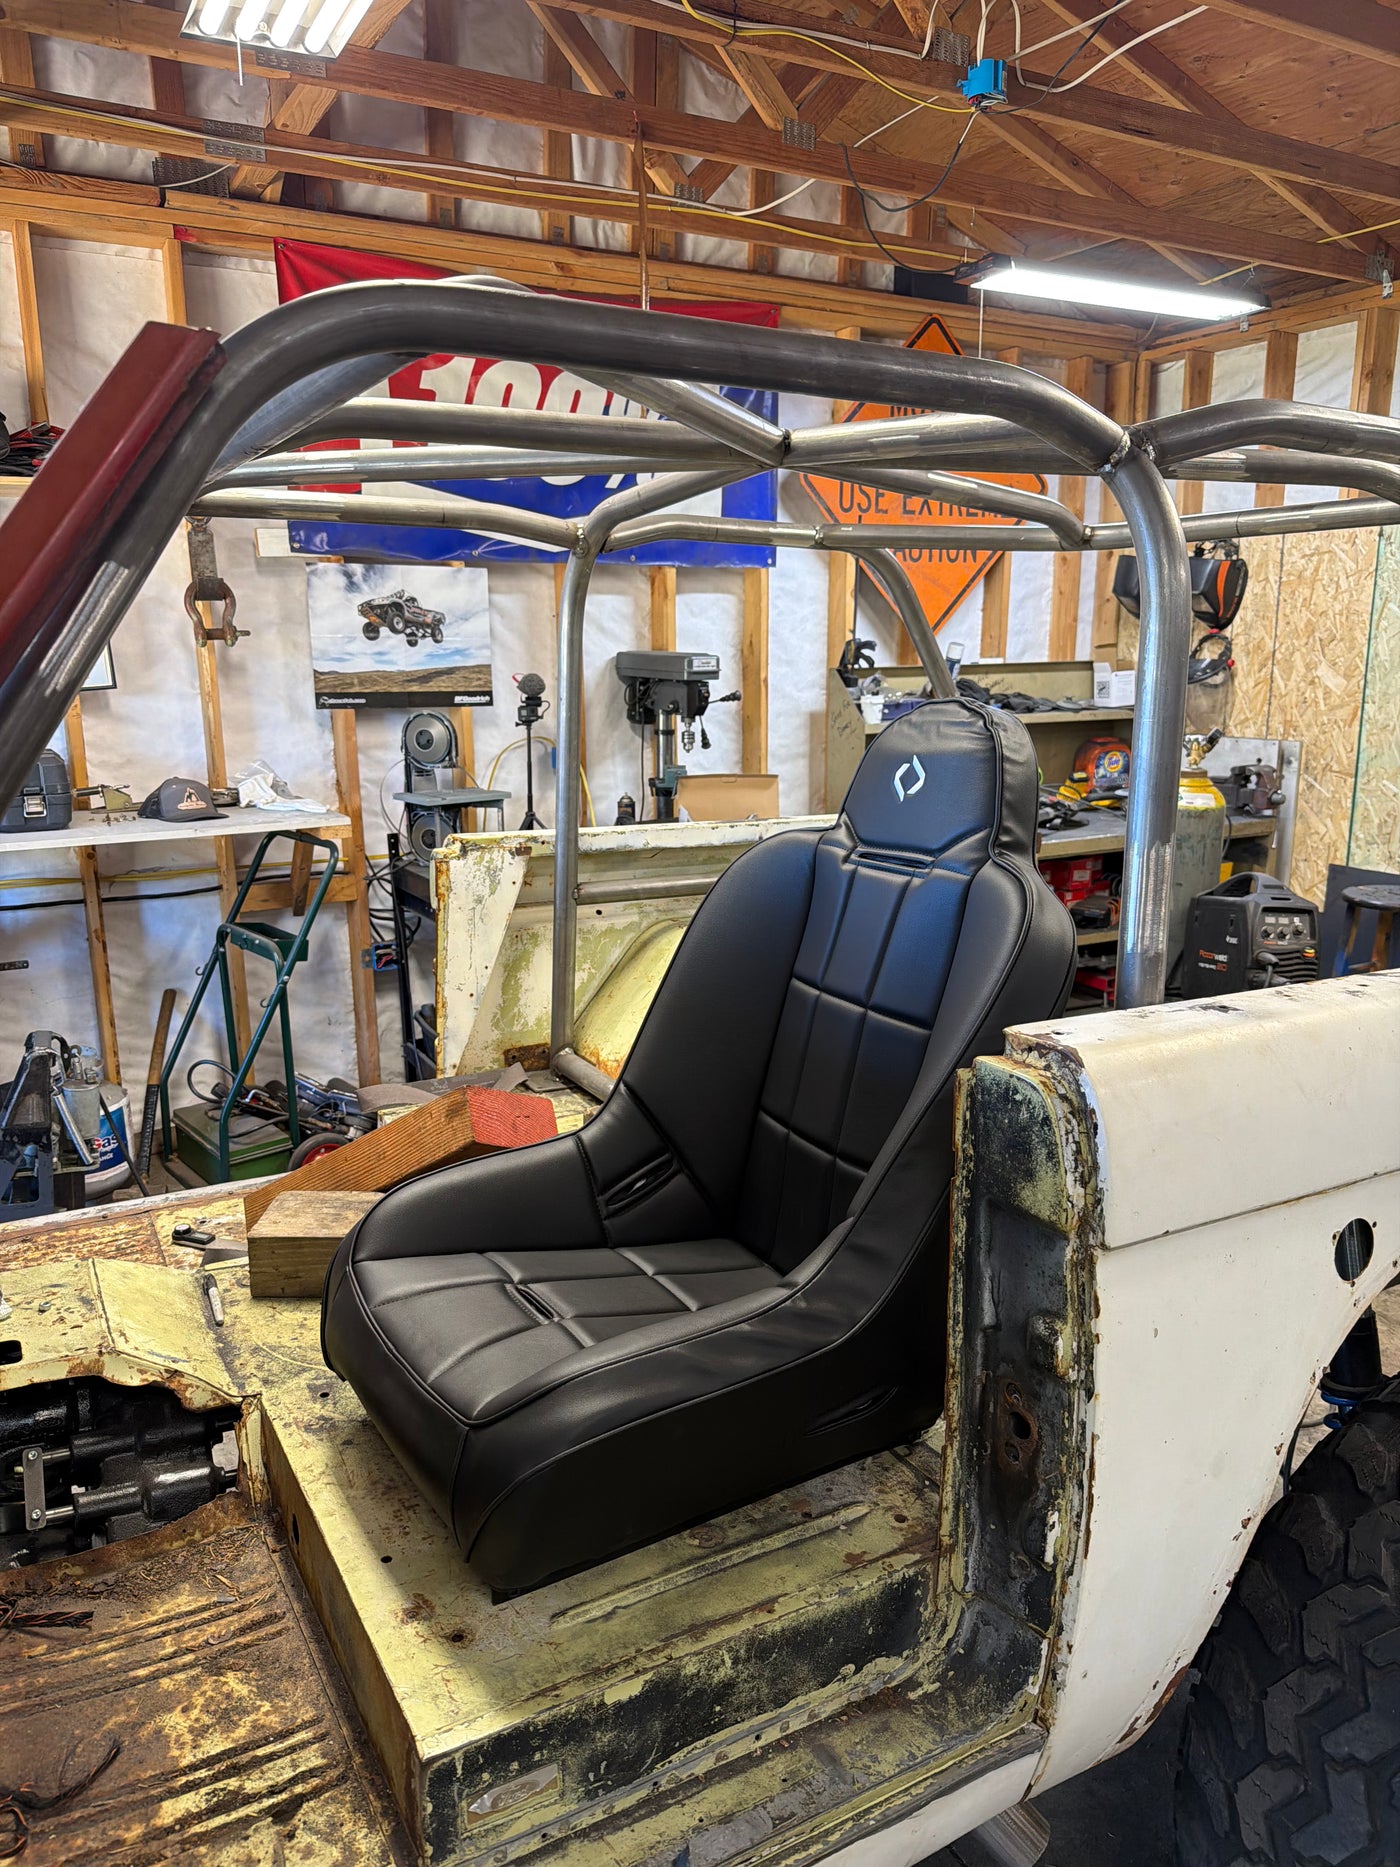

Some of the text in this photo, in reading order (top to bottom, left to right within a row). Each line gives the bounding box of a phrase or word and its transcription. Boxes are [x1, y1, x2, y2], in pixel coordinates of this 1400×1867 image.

[839, 481, 1012, 518] USE EXTRE
[892, 549, 977, 563] AUTION
